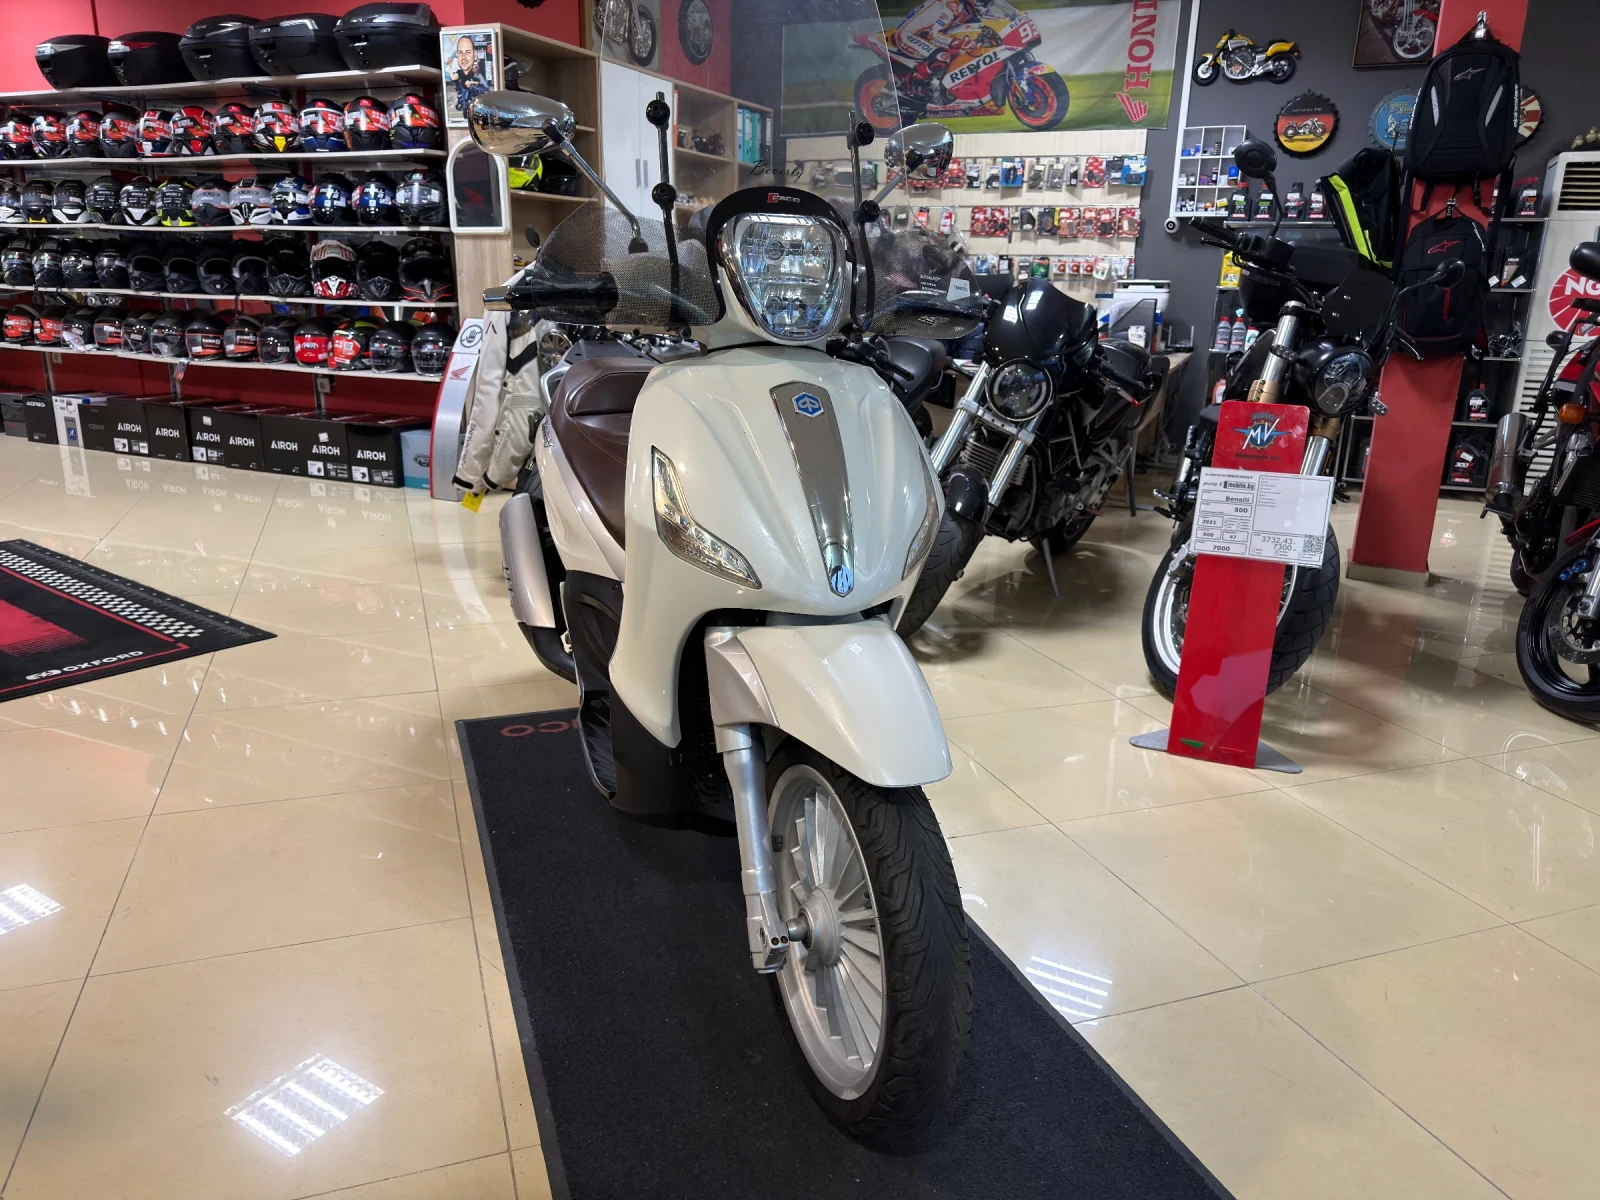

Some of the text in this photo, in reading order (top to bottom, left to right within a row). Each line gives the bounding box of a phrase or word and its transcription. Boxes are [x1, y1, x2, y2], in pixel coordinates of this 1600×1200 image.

[1018, 20, 1039, 44] 93
[907, 35, 933, 53] REPSOL
[949, 51, 1001, 84] REPSOL
[750, 160, 804, 183] Beverly
[768, 193, 801, 203] FACO
[118, 422, 141, 433] AIROH
[155, 427, 179, 438] AIROH
[196, 431, 220, 443] AIROH
[1242, 418, 1280, 450] MV
[229, 435, 255, 447] AIROH
[271, 440, 298, 452] AIROH
[312, 445, 340, 456] AIROH
[356, 450, 386, 461] AIROH
[1227, 482, 1255, 490] mobile.bg
[62, 650, 144, 673] OXFORD
